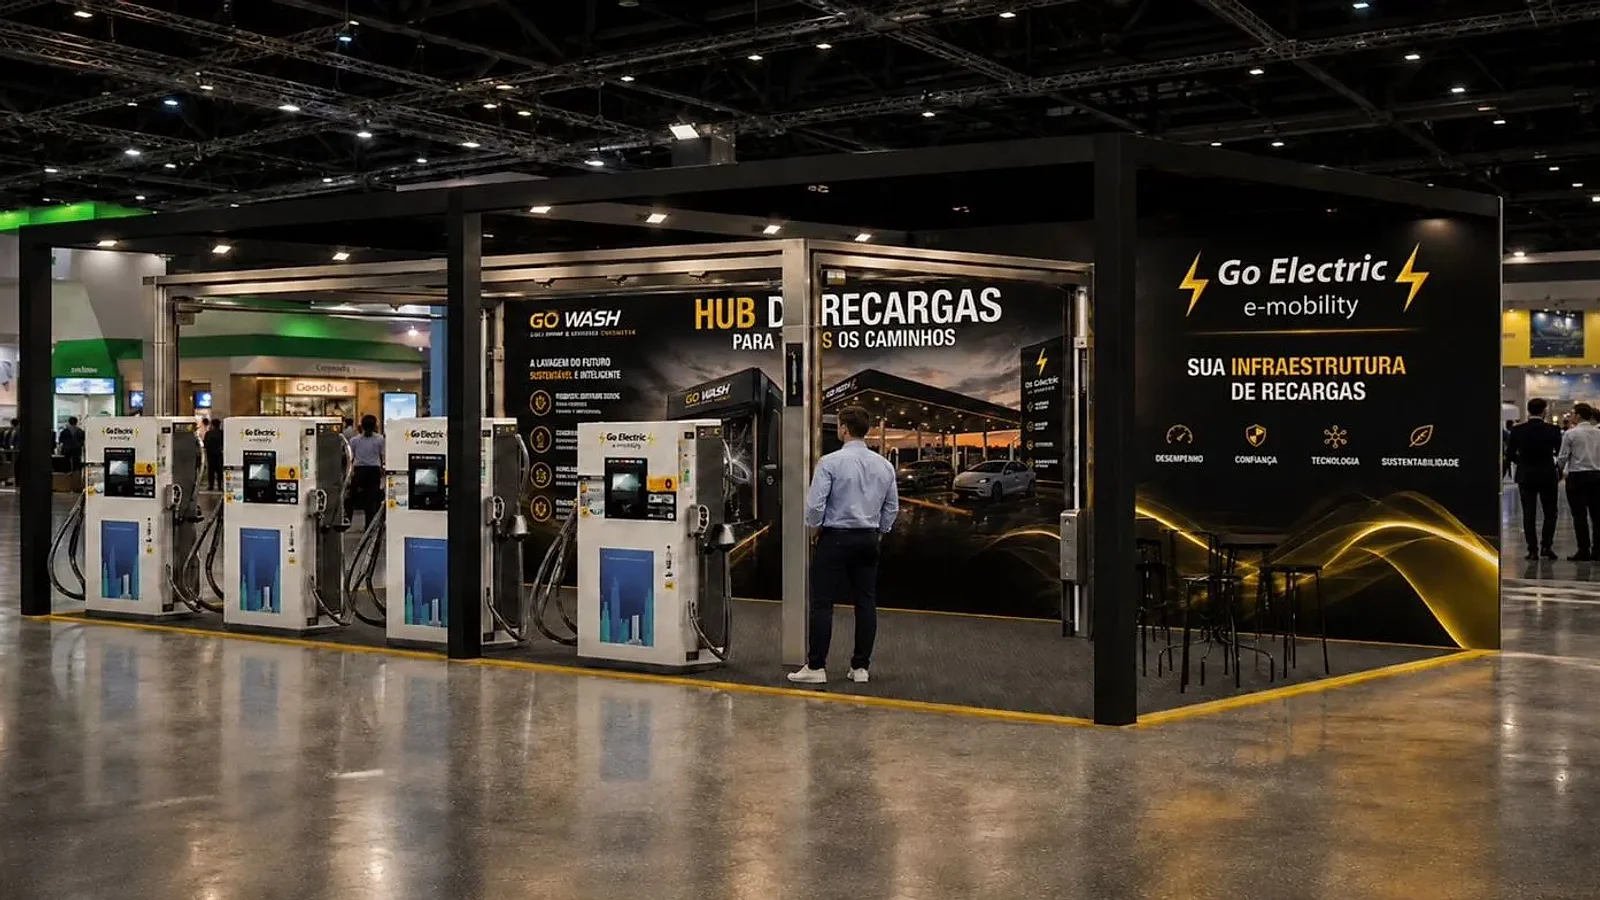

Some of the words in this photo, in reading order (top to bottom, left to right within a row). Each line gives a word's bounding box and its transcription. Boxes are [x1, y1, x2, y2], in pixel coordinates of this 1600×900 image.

[1218, 258, 1261, 286] Go
[1269, 253, 1388, 285] Electric
[695, 296, 756, 330] HUB
[821, 287, 1003, 327] RECARGAS
[1243, 294, 1359, 320] e-mobility
[530, 312, 559, 329] GO
[565, 309, 621, 328] WASH
[732, 331, 774, 350] PARA
[838, 330, 860, 349] OS
[864, 328, 956, 348] CAMINHOS
[529, 358, 536, 368] A
[536, 357, 569, 368] LAVAGEM
[570, 357, 581, 368] DO
[582, 357, 611, 368] FUTURO
[1187, 358, 1226, 376] SUA
[1231, 355, 1407, 376] INFRAESTRUTURA
[685, 392, 700, 405] GO
[701, 383, 731, 401] WASH
[1231, 382, 1256, 401] DE
[1261, 381, 1366, 401] RECARGAS
[606, 432, 617, 441] Go
[618, 432, 646, 441] Electric
[1155, 454, 1204, 463] DESEMPENHO
[1234, 455, 1278, 466] CONFIANÇA
[1311, 456, 1361, 466] TECNOLOGIA
[1381, 457, 1461, 468] SUSTENTABILIDADE
